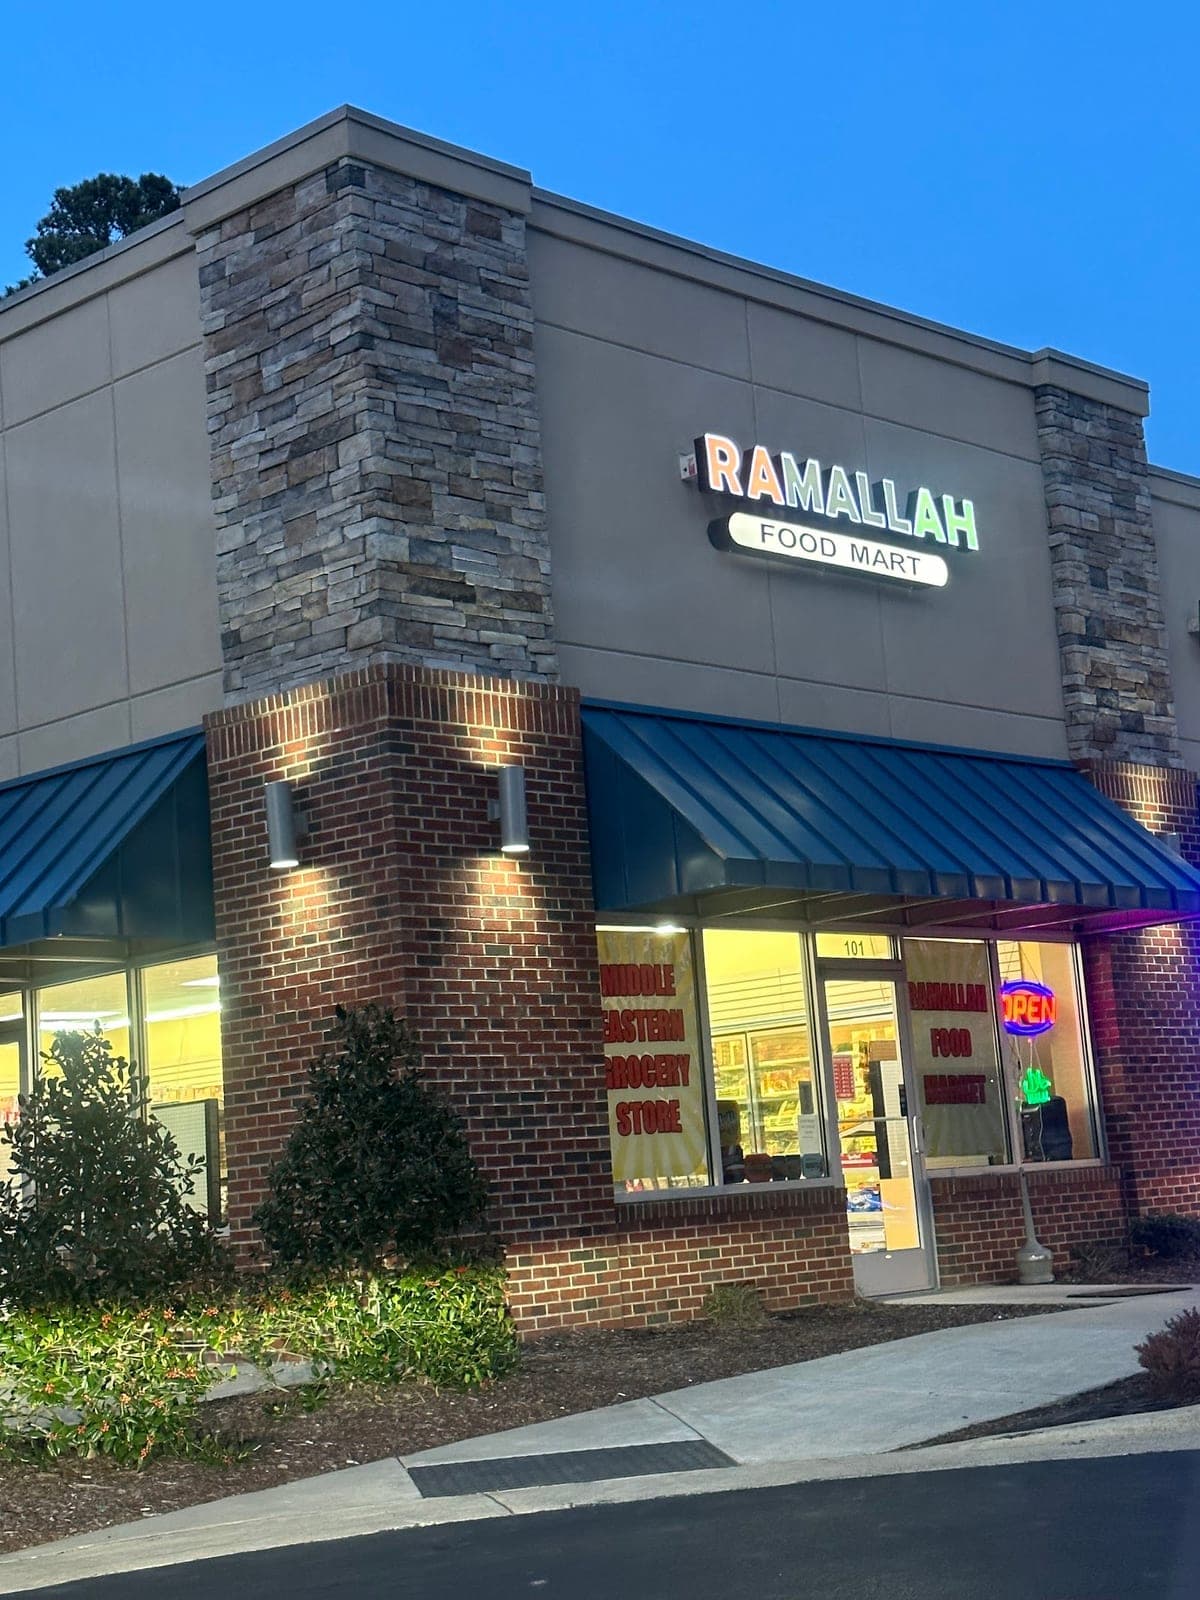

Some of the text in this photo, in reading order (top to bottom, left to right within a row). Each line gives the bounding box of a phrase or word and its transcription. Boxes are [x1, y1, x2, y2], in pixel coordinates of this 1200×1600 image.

[704, 432, 979, 551] RAMALLAH
[760, 523, 921, 576] FOOD MART
[844, 939, 864, 956] 101
[600, 964, 676, 996] MIDDLE
[930, 1028, 972, 1058] FOOD
[616, 1100, 682, 1137] STORE
